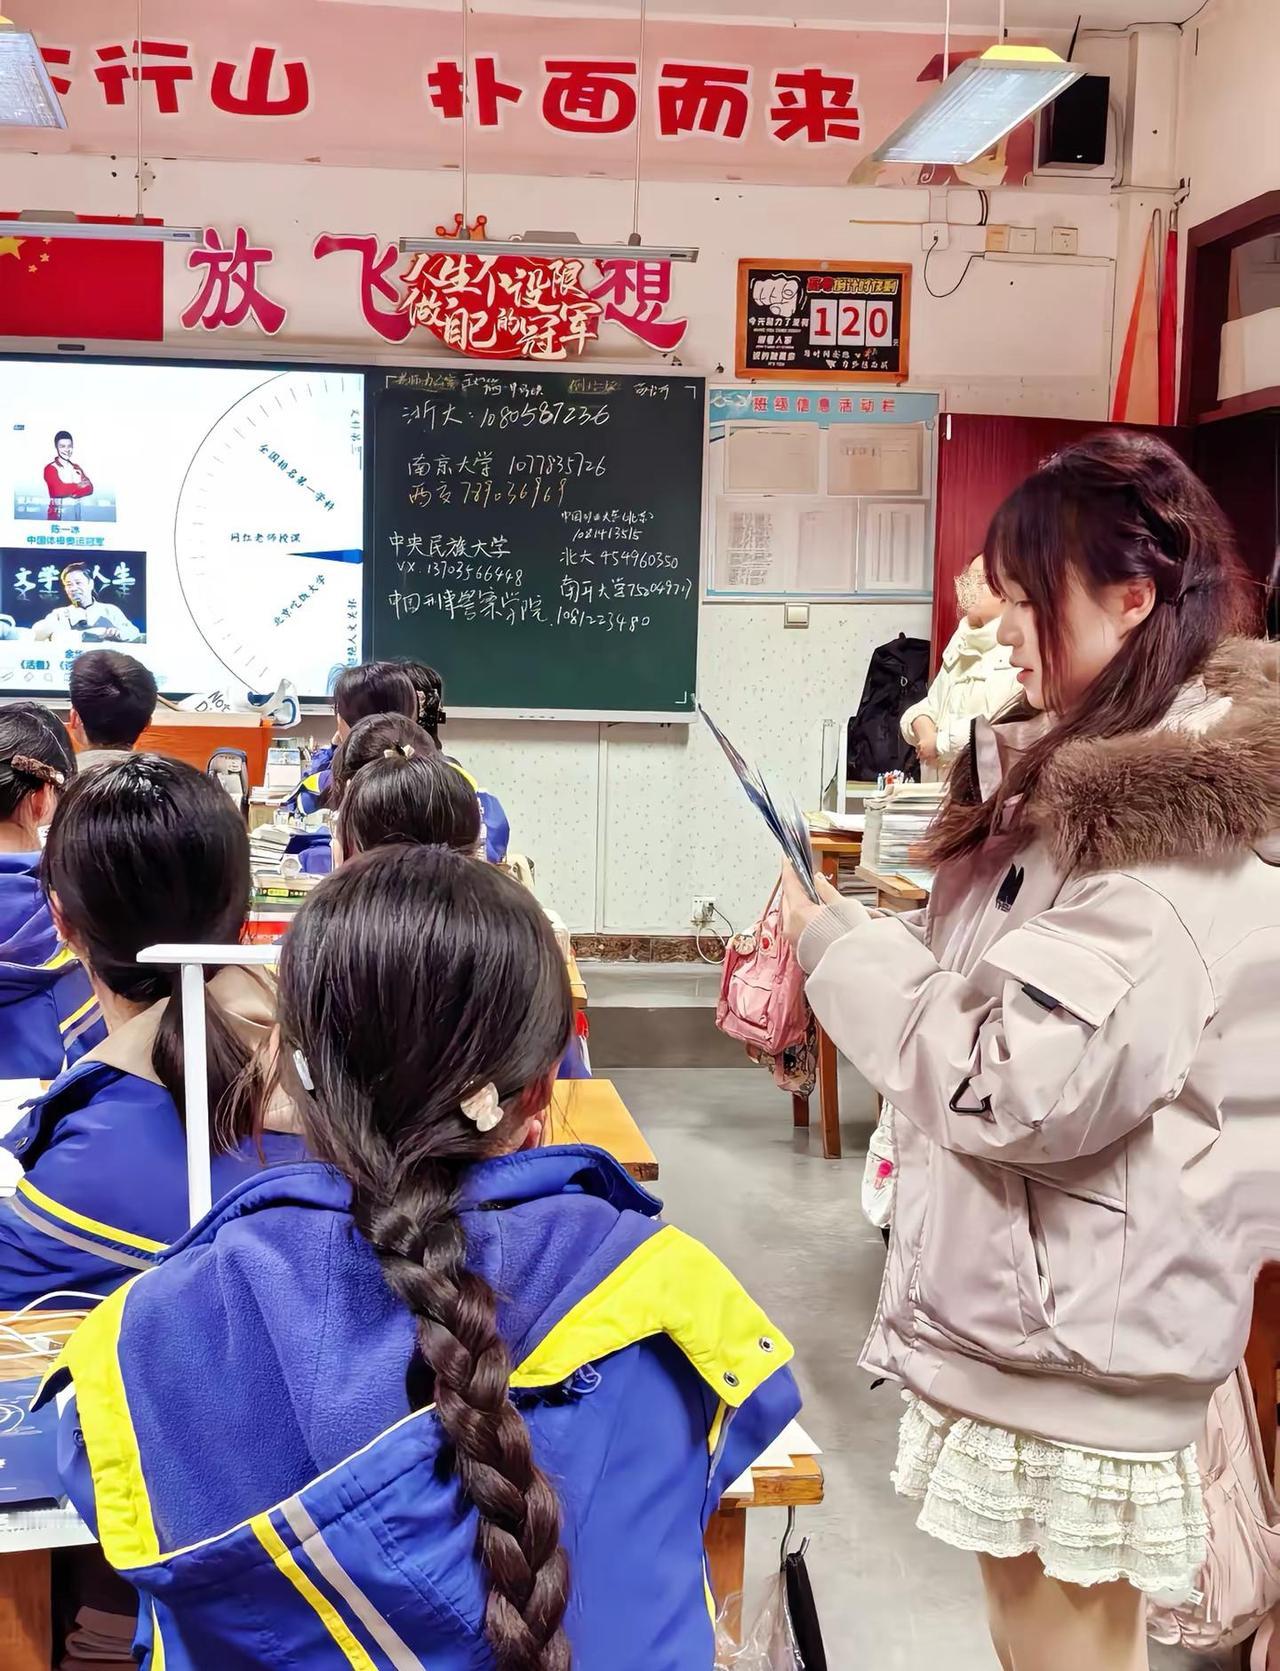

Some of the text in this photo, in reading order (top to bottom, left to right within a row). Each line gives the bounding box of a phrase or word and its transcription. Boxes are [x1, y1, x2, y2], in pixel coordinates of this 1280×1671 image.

[427, 57, 861, 143] 扑面而来
[400, 288, 605, 361] 做自己的冠军
[814, 306, 888, 337] 120
[752, 396, 896, 414] 班级信息活动栏
[408, 451, 607, 477] 南京大学 1077835726
[388, 530, 512, 558] 中央民族大学
[559, 547, 596, 566] 北大
[560, 574, 626, 603] 南开大学
